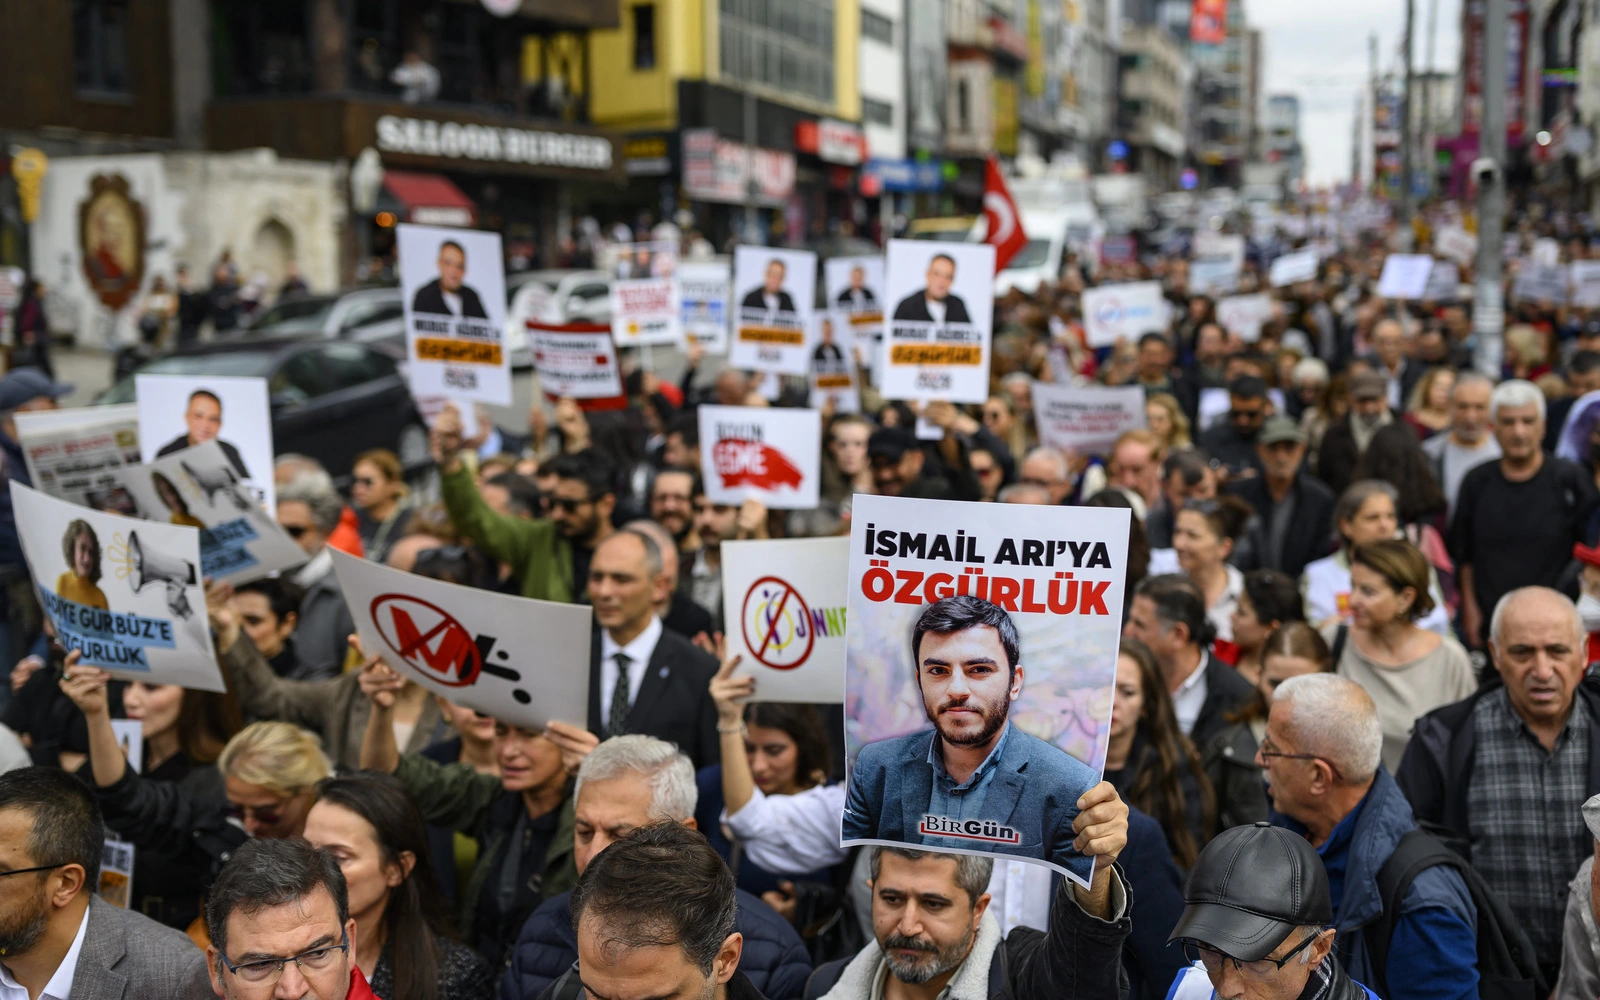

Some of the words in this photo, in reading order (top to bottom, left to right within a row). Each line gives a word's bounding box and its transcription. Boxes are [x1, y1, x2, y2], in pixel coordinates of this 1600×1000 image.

[376, 114, 500, 161] SALOON
[864, 523, 985, 563] İSMAİL
[861, 559, 1112, 615] ÖZGÜRLÜK
[79, 603, 171, 641] GÜRBÜZ'E
